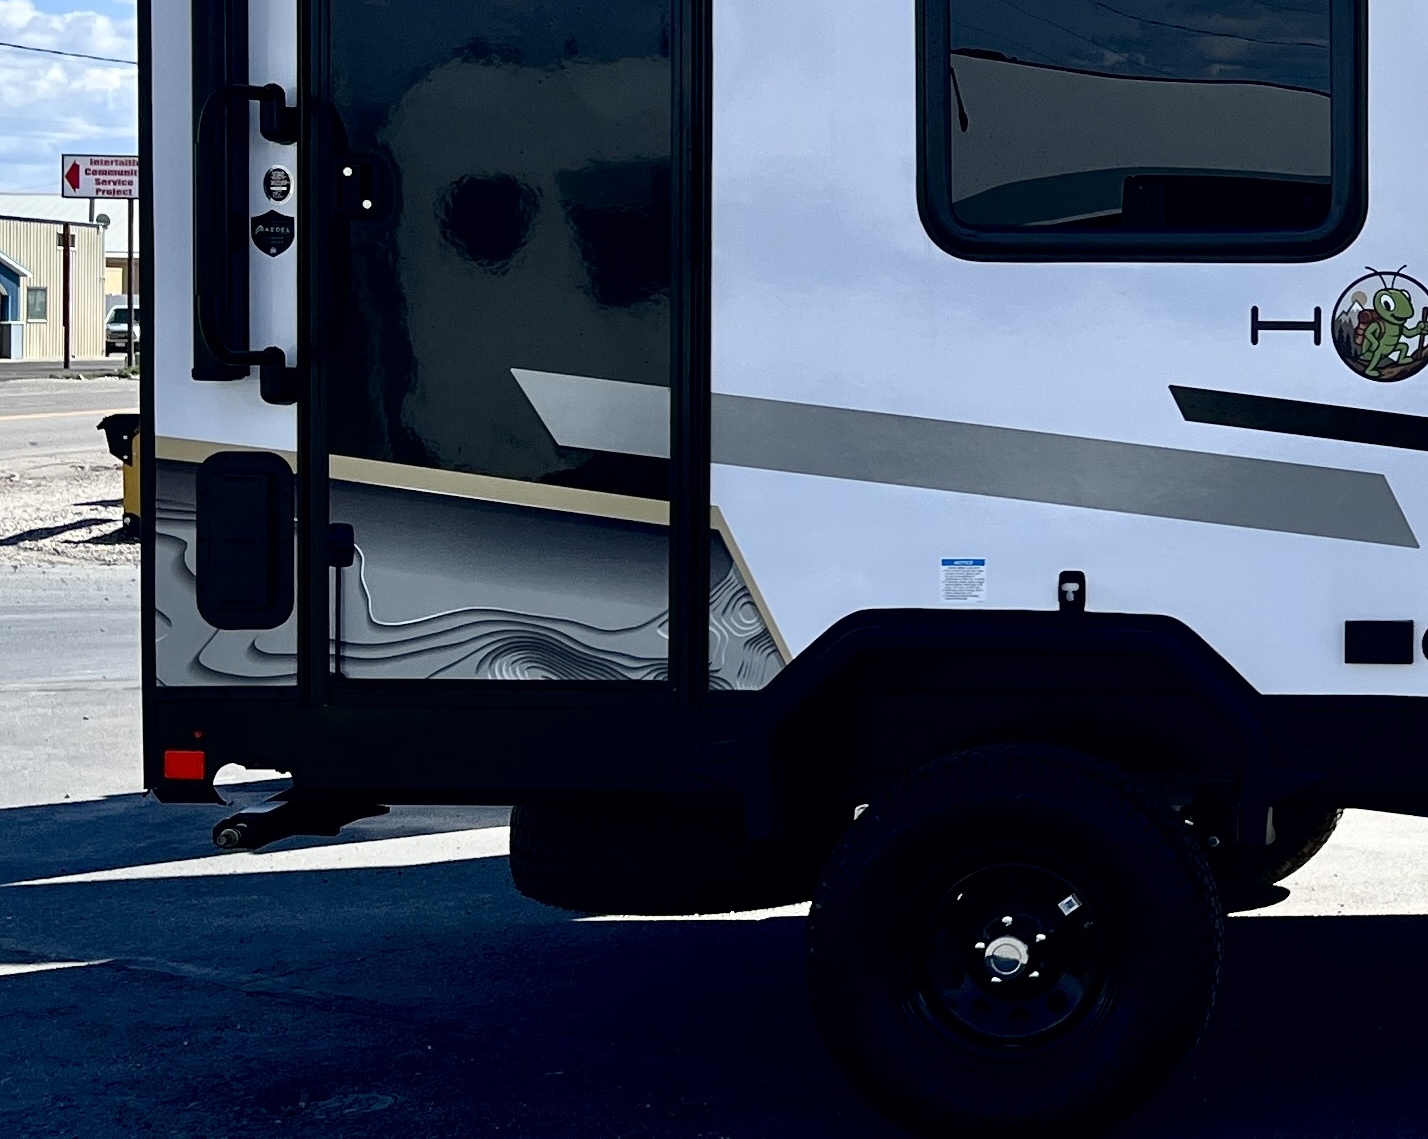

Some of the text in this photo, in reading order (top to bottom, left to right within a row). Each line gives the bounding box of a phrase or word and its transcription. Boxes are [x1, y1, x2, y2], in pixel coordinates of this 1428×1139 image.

[84, 168, 138, 177] Communit
[94, 178, 134, 186] Service
[95, 188, 134, 197] Project
